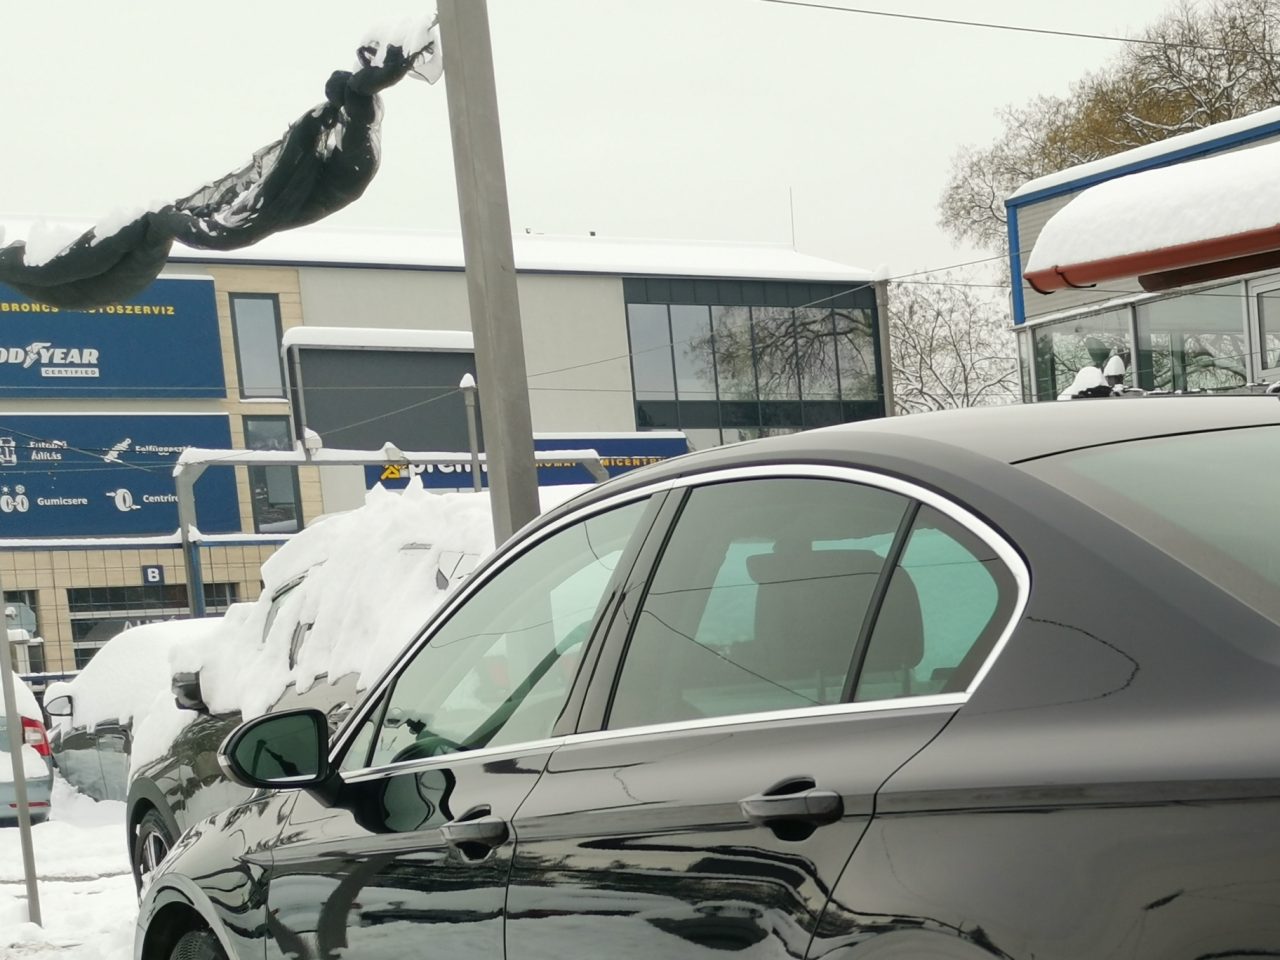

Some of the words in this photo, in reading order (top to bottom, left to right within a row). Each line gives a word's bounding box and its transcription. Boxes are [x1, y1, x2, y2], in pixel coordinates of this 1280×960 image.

[44, 369, 97, 377] CERTIFIED
[37, 497, 88, 506] Gumicsere
[147, 567, 160, 582] B
